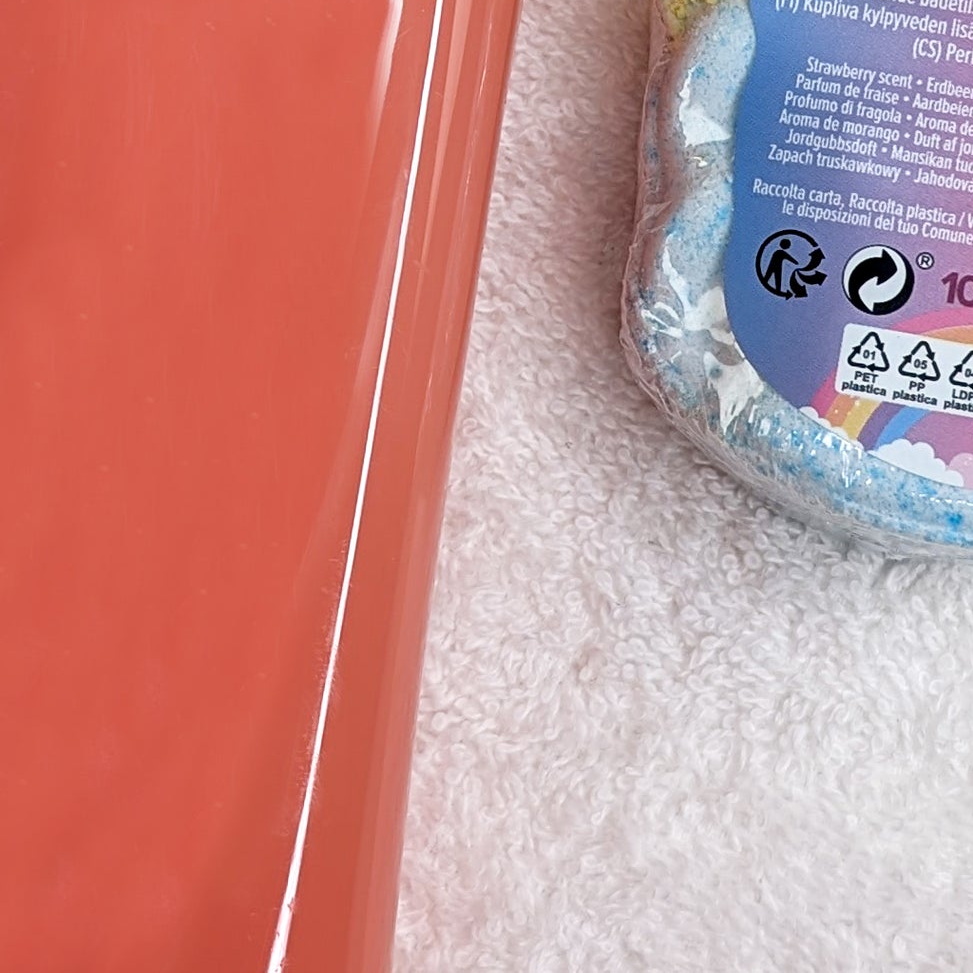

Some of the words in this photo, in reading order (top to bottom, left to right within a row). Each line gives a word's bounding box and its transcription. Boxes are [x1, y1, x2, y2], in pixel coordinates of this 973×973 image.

[862, 4, 947, 33] kylpyveden
[913, 38, 941, 63] (CS)
[806, 56, 875, 85] Strawberry
[878, 70, 912, 89] scent
[795, 74, 840, 95] Parfum
[844, 81, 859, 97] de
[864, 85, 899, 104] fraise
[784, 91, 838, 113] Profumo
[841, 101, 852, 114] di
[857, 102, 901, 125] fragola
[915, 114, 956, 133] Aroma
[780, 109, 819, 128] Aroma
[823, 115, 839, 131] de
[843, 120, 899, 144] morango
[914, 132, 940, 149] Duft
[944, 137, 957, 152] af
[768, 145, 813, 164] Zapach
[816, 151, 901, 182] truskawkowy
[785, 129, 877, 157] Jordgubbsdoft
[891, 145, 951, 170] Mansikan
[753, 178, 804, 200] Raccolta
[809, 189, 844, 207] carta,
[850, 193, 903, 216] Raccolta
[907, 205, 956, 226] plastica
[782, 200, 794, 215] le
[797, 203, 871, 226] disposizioni
[874, 215, 894, 230] del
[898, 219, 918, 235] tuo
[863, 350, 876, 360] 01
[914, 359, 927, 369] 05
[842, 382, 887, 396] plastica
[854, 371, 879, 383] PET
[909, 381, 925, 391] PP
[893, 392, 937, 406] plastica
